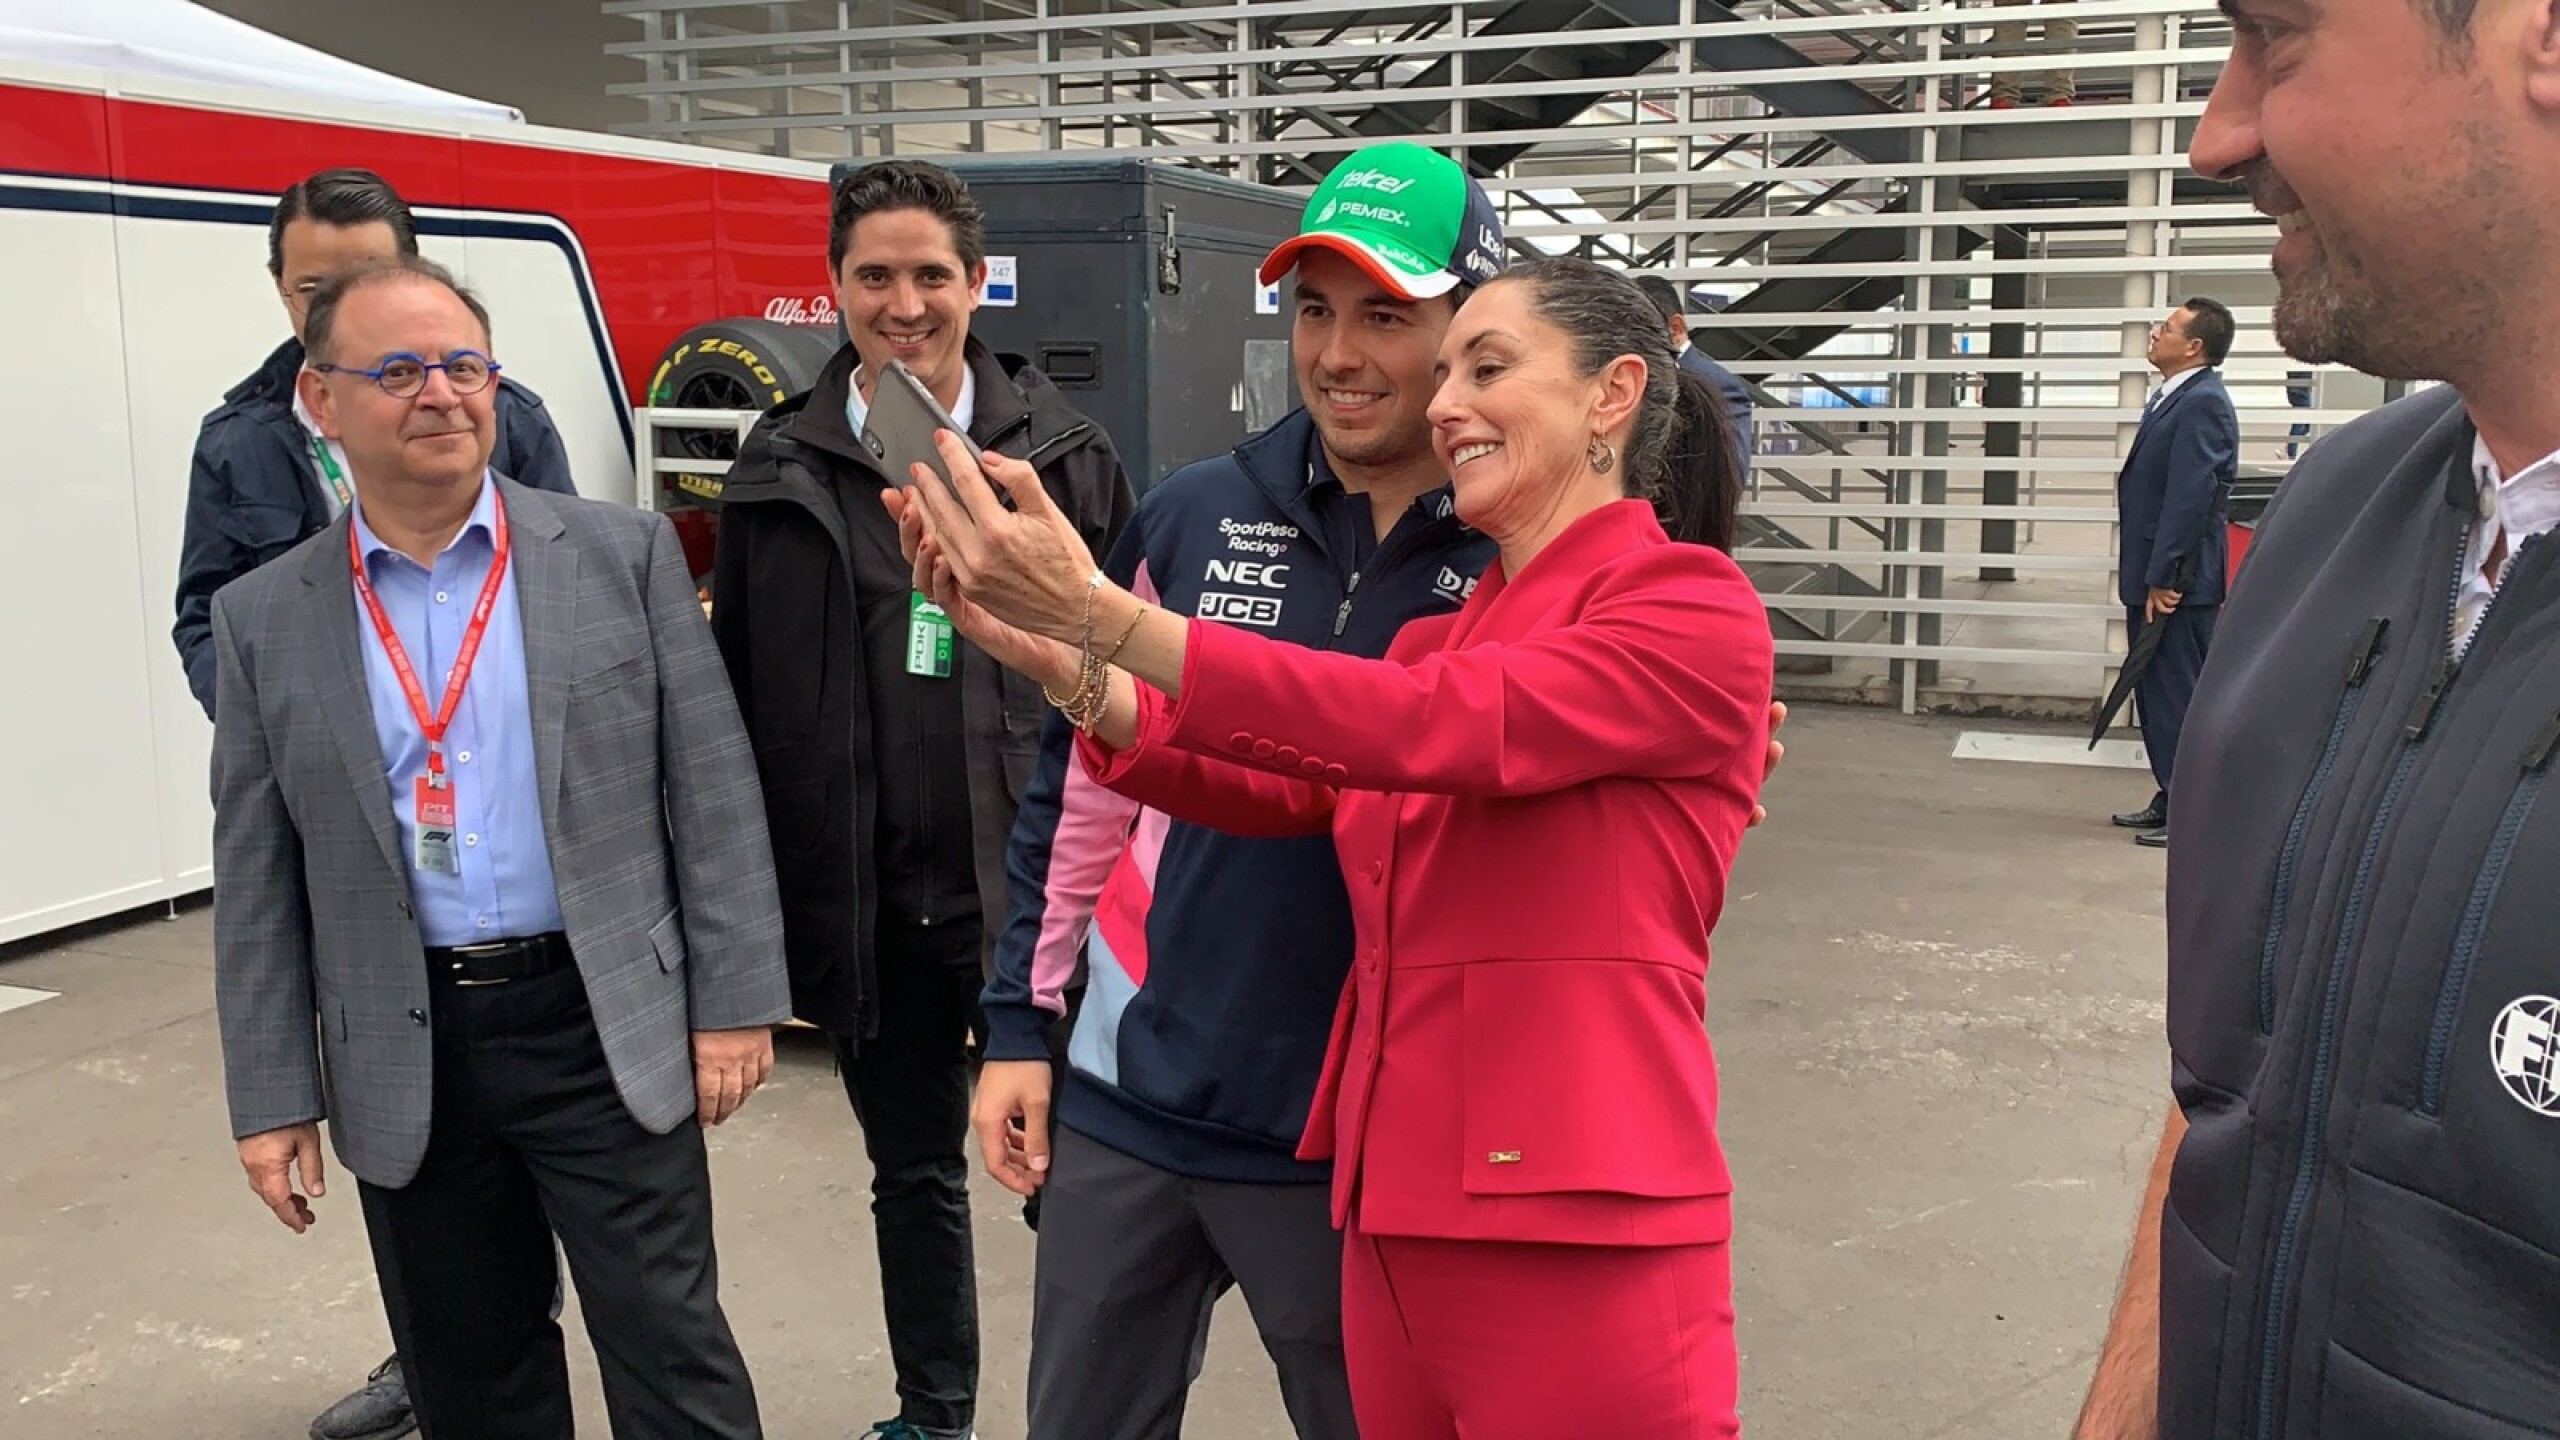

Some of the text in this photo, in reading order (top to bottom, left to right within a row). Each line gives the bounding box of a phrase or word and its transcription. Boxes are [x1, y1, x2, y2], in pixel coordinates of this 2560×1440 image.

[1336, 168, 1416, 194] telcel
[764, 297, 808, 326] Alfa
[698, 338, 776, 384] ZERO
[1218, 517, 1299, 539] SportPesa
[1228, 535, 1280, 558] Racing
[1204, 559, 1291, 589] NEC
[1201, 595, 1278, 622] JCB
